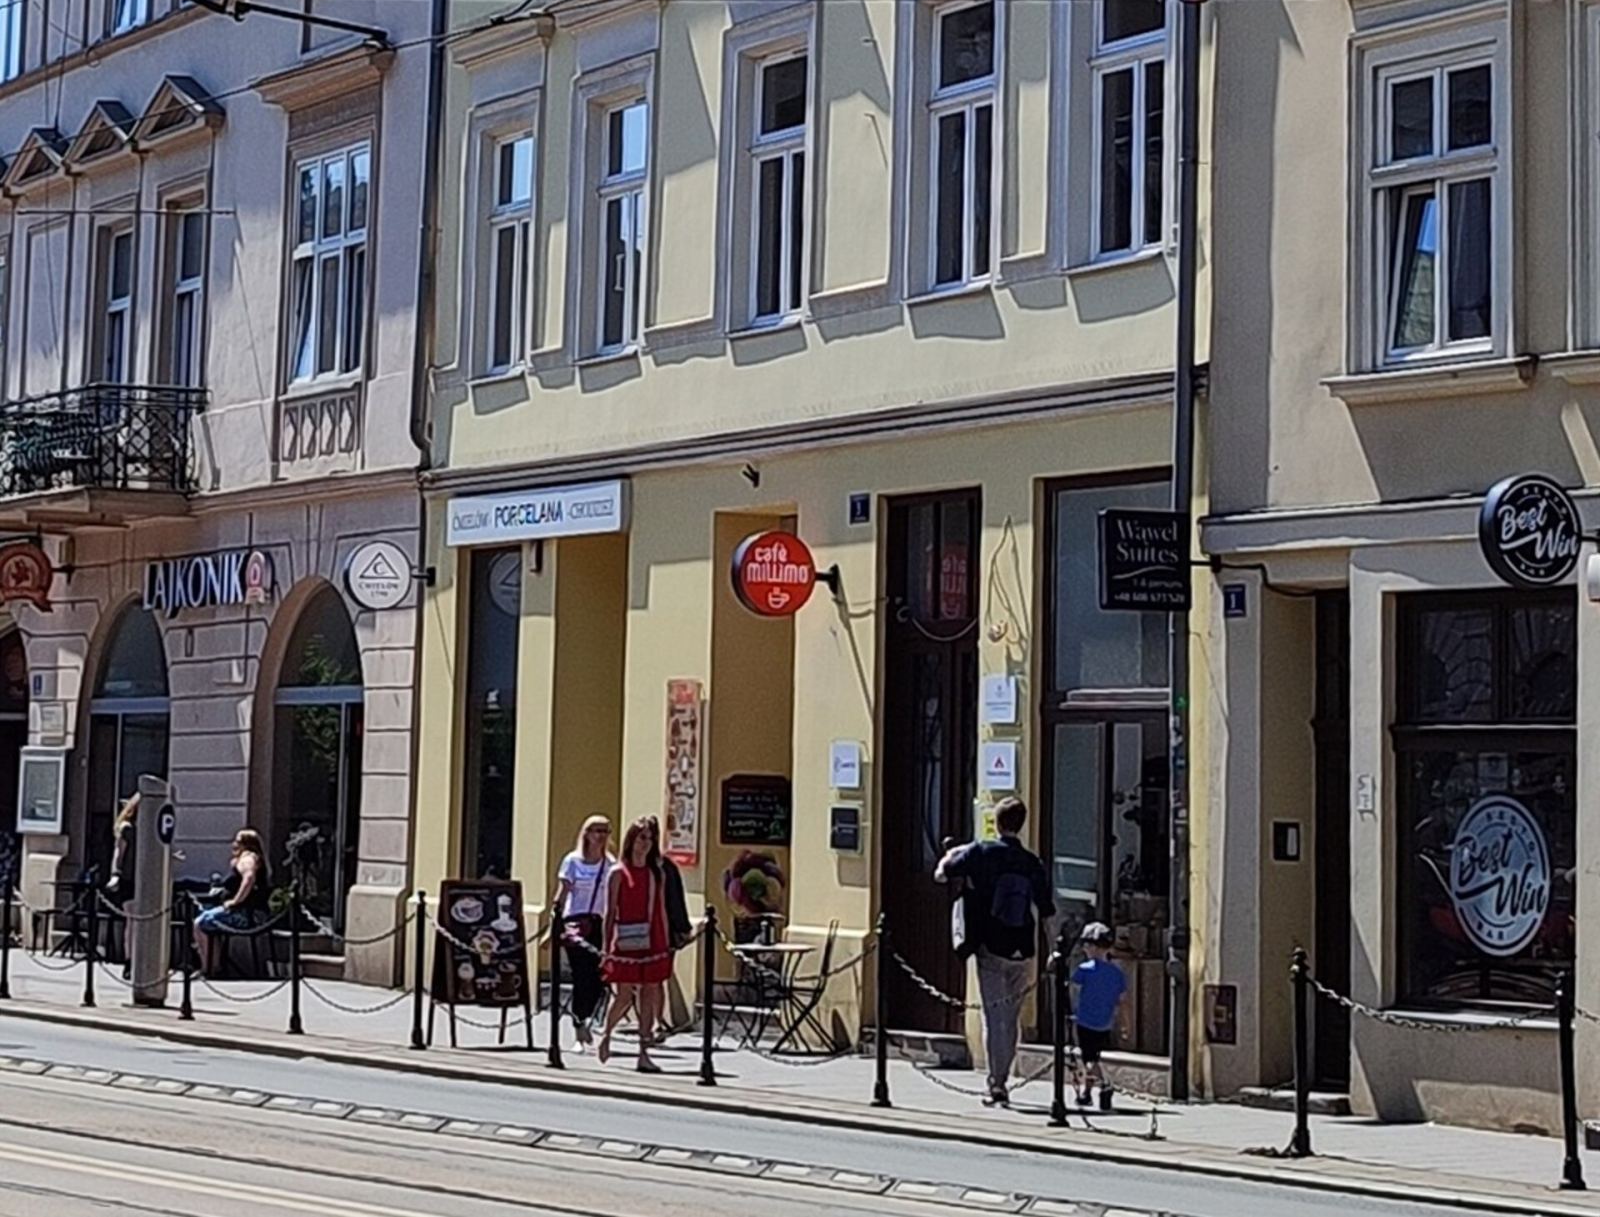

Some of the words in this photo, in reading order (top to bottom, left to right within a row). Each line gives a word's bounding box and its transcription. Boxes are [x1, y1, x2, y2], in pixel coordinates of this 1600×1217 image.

[494, 500, 564, 529] PORCELANA
[1498, 498, 1548, 541] Best
[1116, 542, 1180, 563] Suites
[1515, 520, 1579, 559] Win
[142, 552, 246, 619] LAJKONIK
[161, 813, 175, 835] P
[1457, 827, 1514, 887] Best
[1474, 862, 1546, 918] Win
